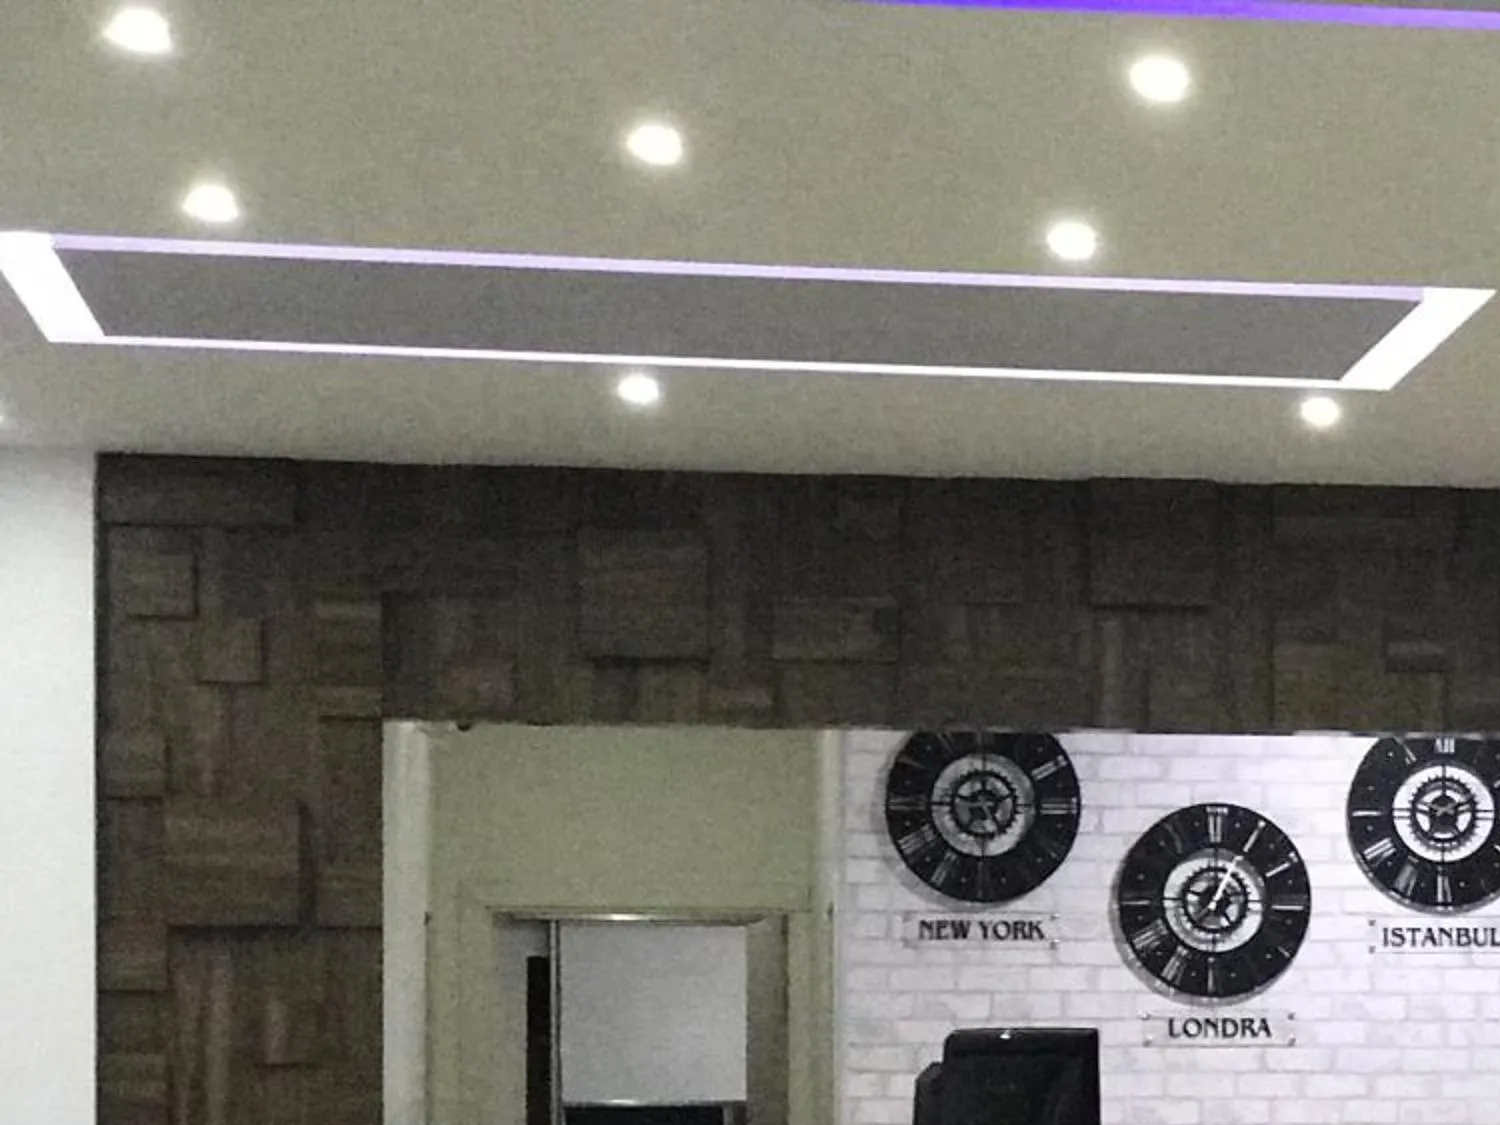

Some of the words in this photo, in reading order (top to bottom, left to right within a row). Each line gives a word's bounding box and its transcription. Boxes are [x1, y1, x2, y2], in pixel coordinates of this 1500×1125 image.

[919, 920, 971, 940] NEW
[979, 920, 1045, 940] YORK
[1168, 1017, 1272, 1038] LONDRA
